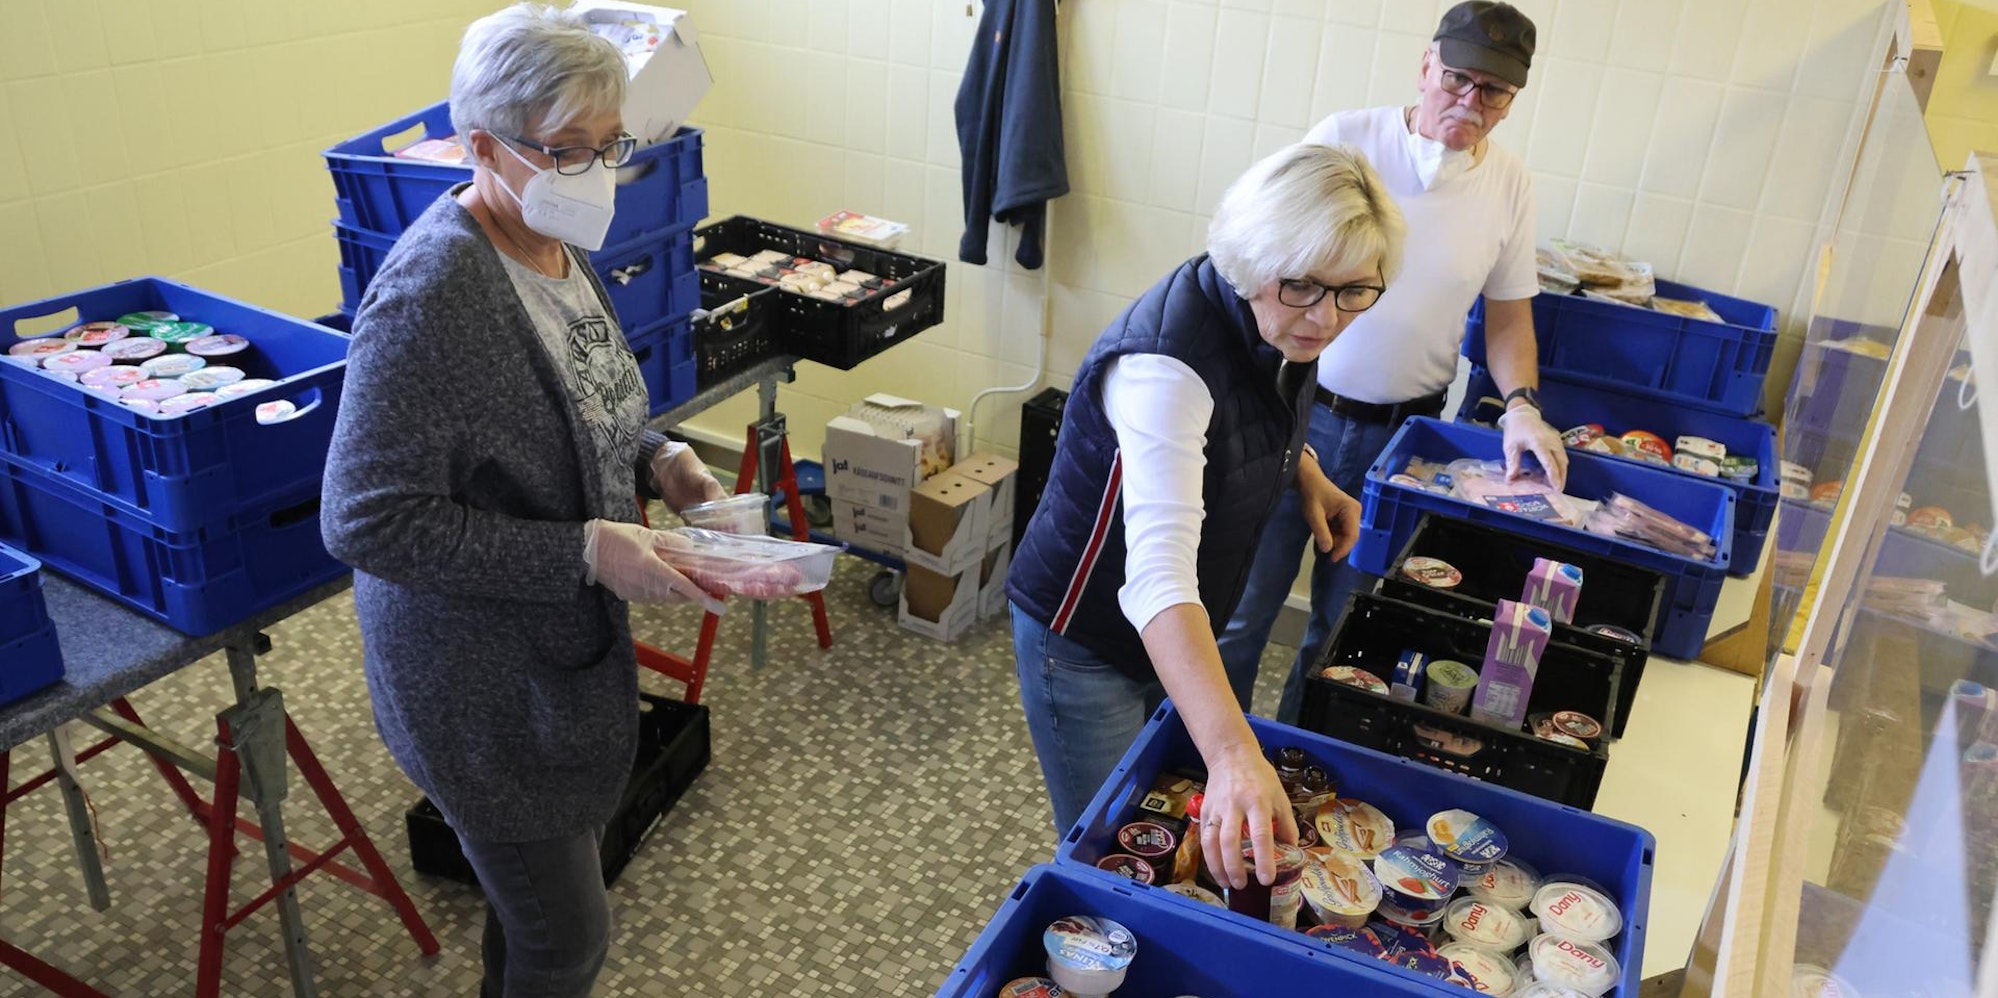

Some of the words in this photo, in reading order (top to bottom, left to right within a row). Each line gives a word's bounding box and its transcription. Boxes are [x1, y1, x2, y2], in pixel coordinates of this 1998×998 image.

[1392, 849, 1452, 888] Rahmjoghurt
[1460, 902, 1488, 932] Dany
[1548, 891, 1583, 916] Dany
[1557, 940, 1606, 969] Dany
